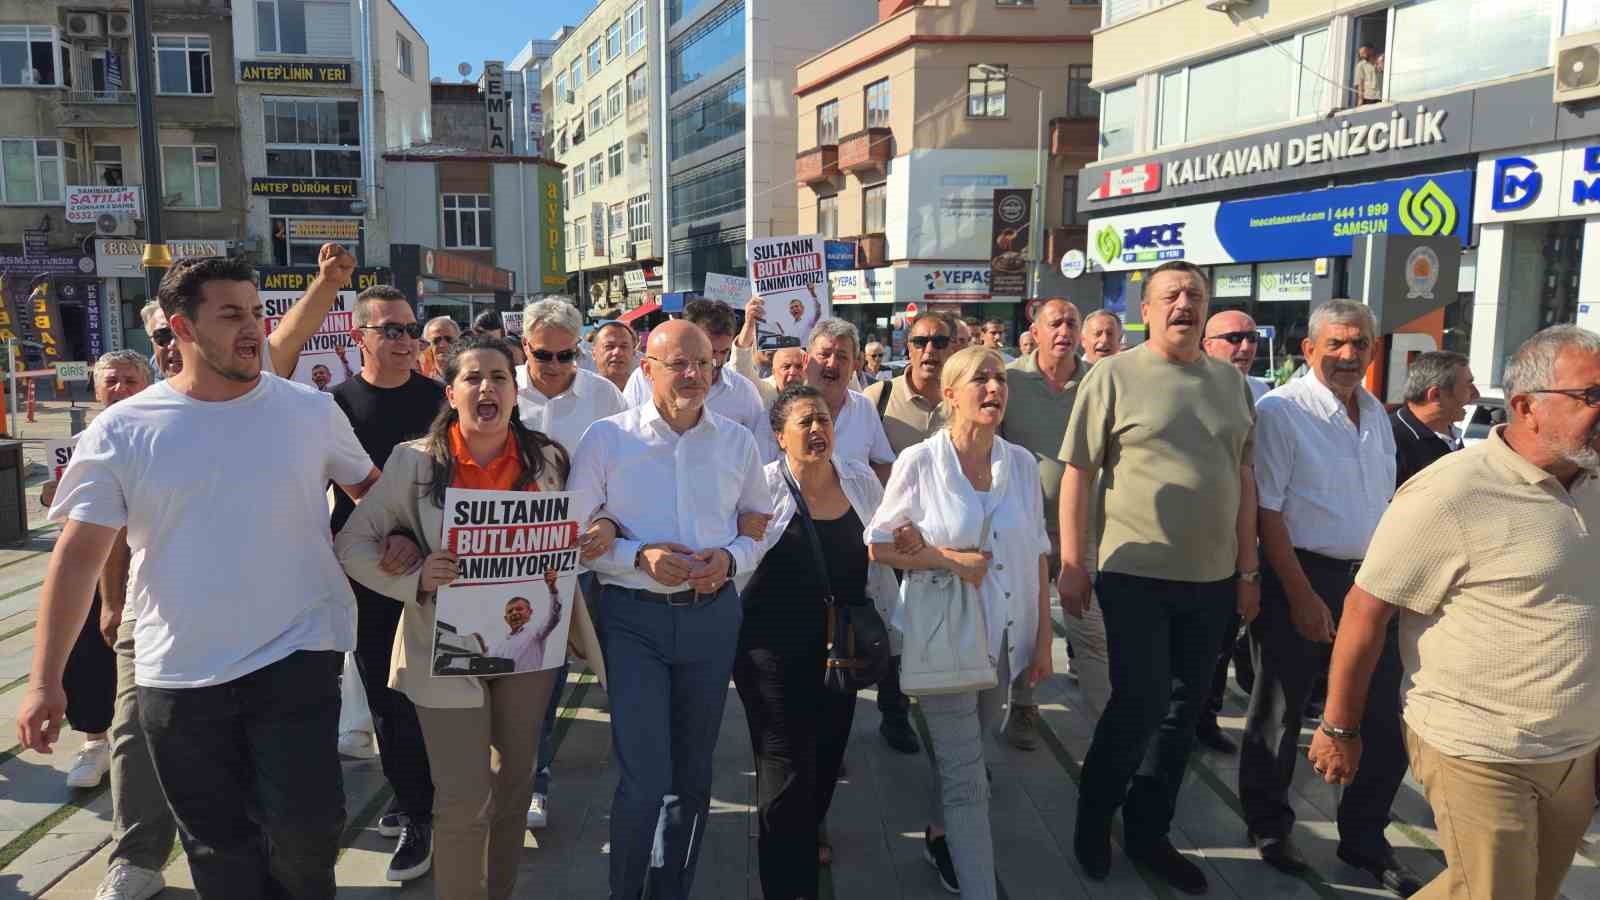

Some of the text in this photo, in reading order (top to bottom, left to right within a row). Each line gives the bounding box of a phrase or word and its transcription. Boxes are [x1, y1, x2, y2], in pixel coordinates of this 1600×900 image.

[1166, 104, 1446, 186] KALKAVAN DENİZCİLİK
[70, 192, 135, 204] SATILIK
[1334, 206, 1355, 219] 444
[1358, 206, 1363, 217] 1
[1367, 203, 1389, 216] 999
[1334, 219, 1388, 236] SAMSUN
[754, 239, 813, 260] SULTANIN
[758, 254, 817, 278] BUTLANINI
[264, 274, 303, 288] ANTEP
[755, 271, 824, 293] TANIMIYORUZ!
[454, 497, 569, 525] SULTANIN
[457, 524, 571, 555] BUTLANINI
[458, 551, 576, 579] ANIMIYORUZ!
